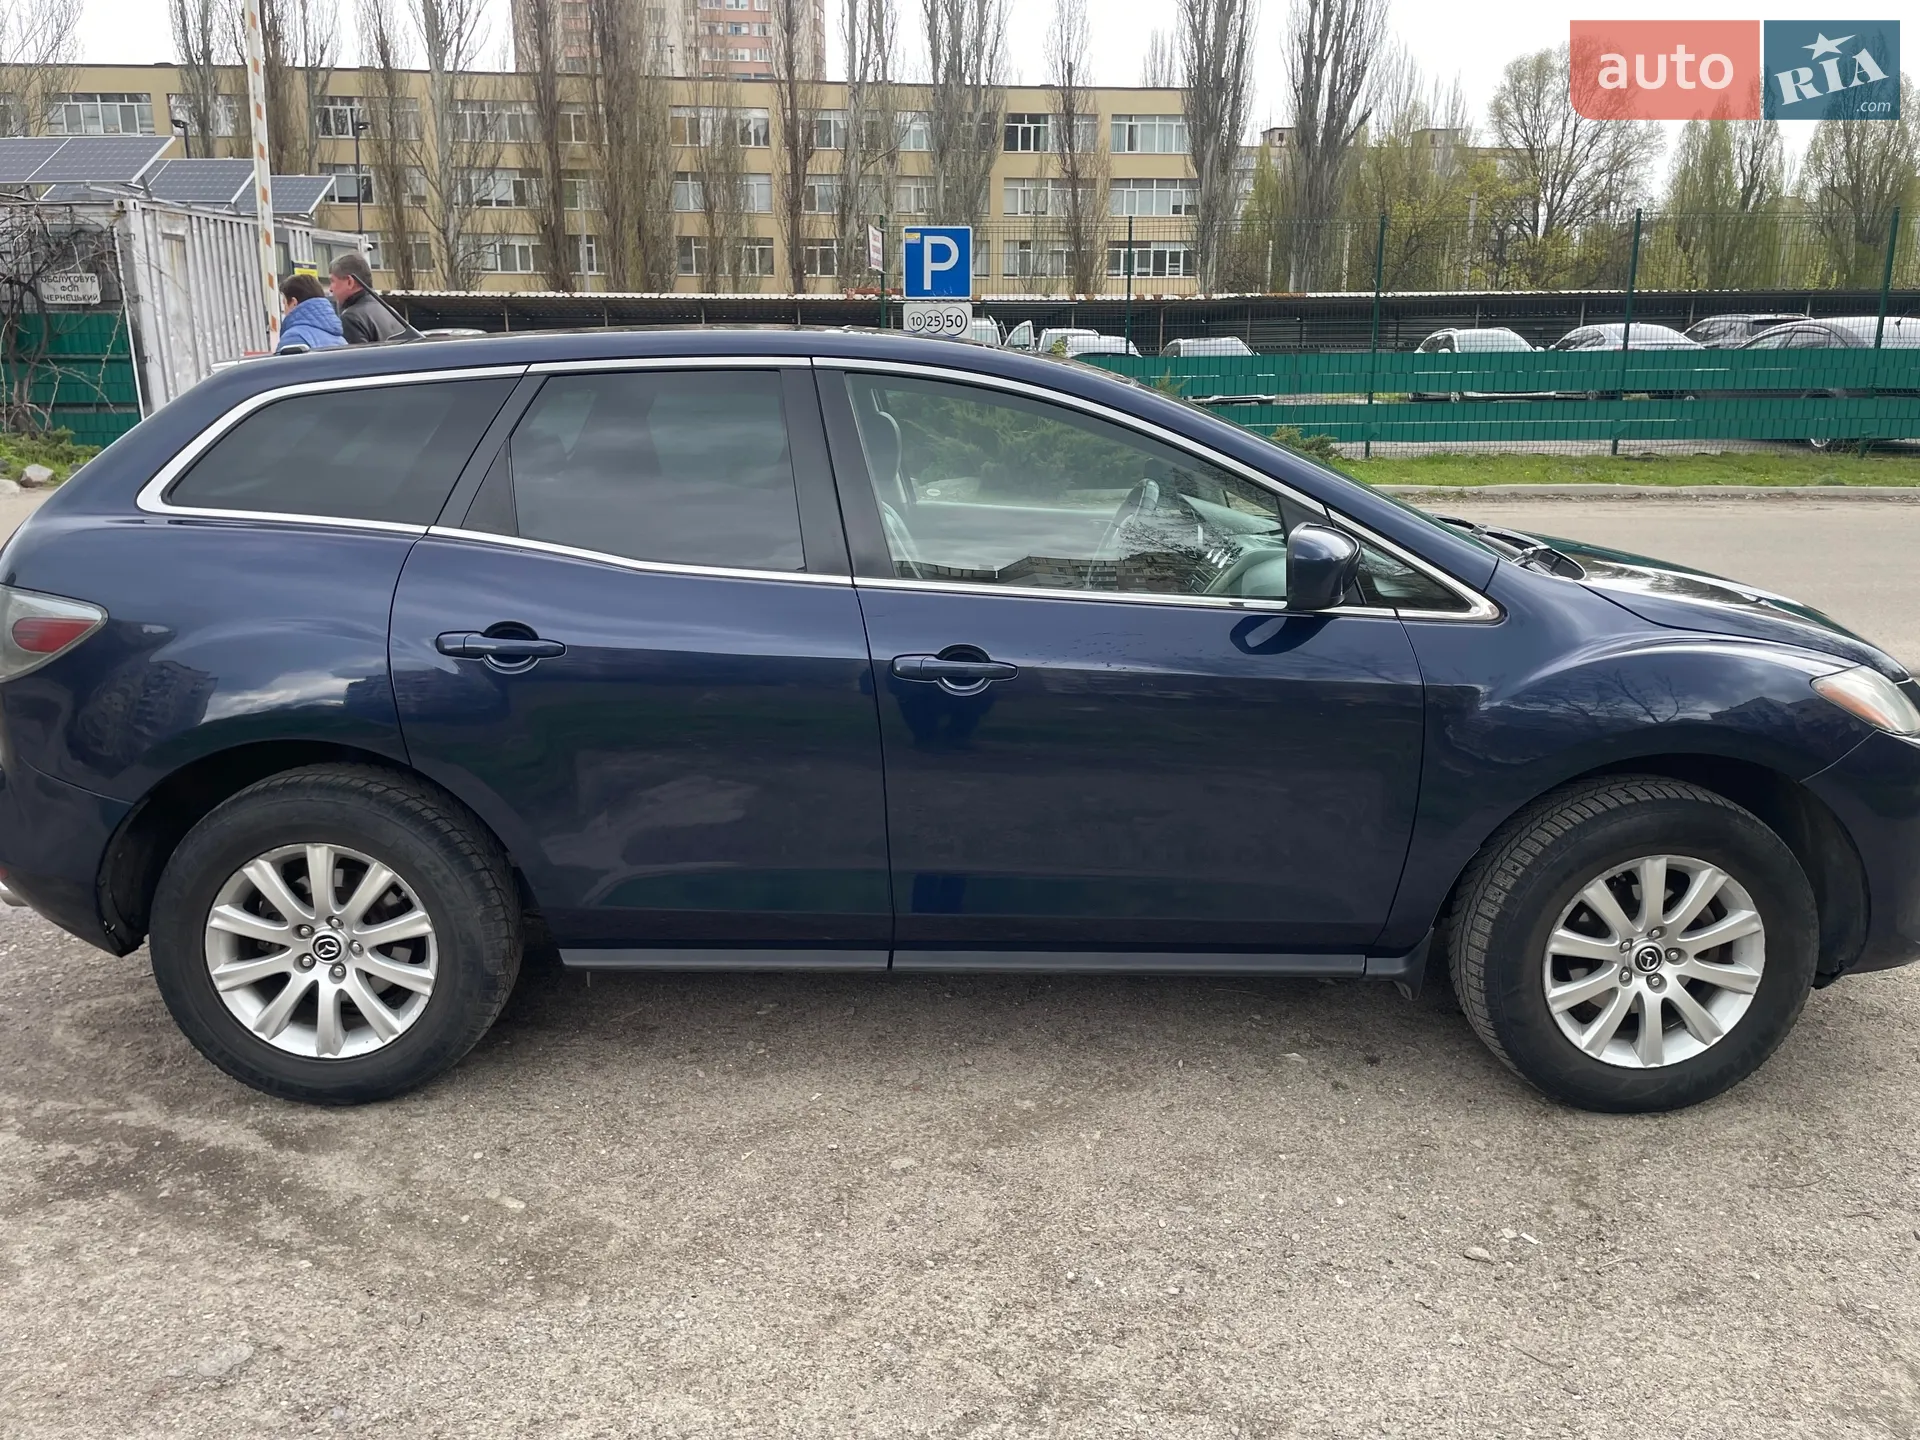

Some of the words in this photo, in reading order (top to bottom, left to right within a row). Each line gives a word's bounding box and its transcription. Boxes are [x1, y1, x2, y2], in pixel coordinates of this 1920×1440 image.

[923, 235, 959, 290] P
[60, 284, 79, 292] ФОП
[43, 293, 99, 302] ЧЕРНЕЦЬКИЙ
[910, 316, 922, 327] 10
[927, 315, 941, 327] 25
[945, 314, 963, 328] 50
